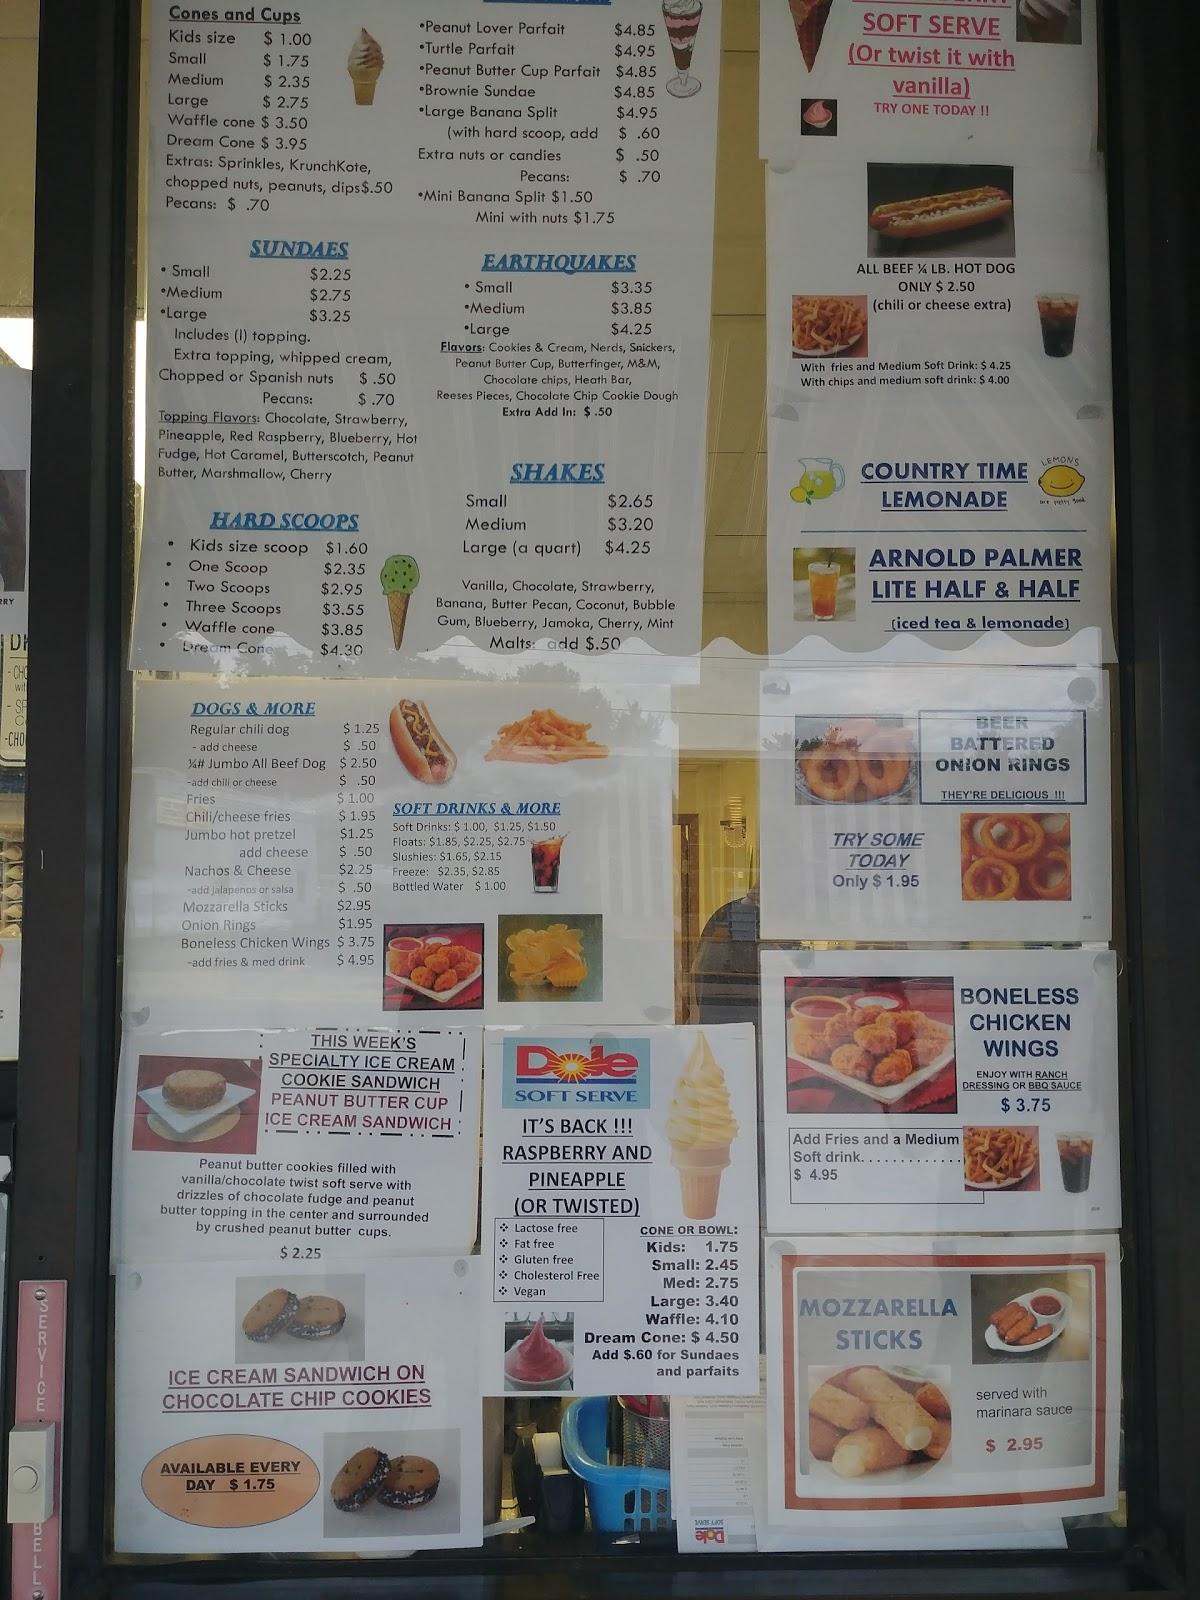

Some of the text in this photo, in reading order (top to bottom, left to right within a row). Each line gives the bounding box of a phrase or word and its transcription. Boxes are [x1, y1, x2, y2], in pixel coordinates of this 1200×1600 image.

[169, 5, 301, 25] Cones and Cups
[862, 12, 1000, 36] SOFT SERVE
[848, 42, 1015, 68] (Or twist it with
[893, 76, 971, 97] vanilla)
[873, 101, 990, 117] TRY ONE TODAY !!
[167, 113, 308, 130] Waffle cone $ 3.50
[166, 154, 371, 175] Extras: Sprinkles, KrunchKote,
[475, 211, 615, 225] Mini with nuts $1.75
[249, 239, 349, 257] SUNDAES
[481, 253, 637, 275] EARTHQUAKES
[856, 262, 880, 275] ALL
[883, 262, 914, 275] BEEF
[931, 262, 950, 275] LB.
[953, 262, 983, 275] HOT
[985, 262, 1016, 275] DOG
[172, 264, 352, 282] Small $2.25
[455, 358, 661, 371] Peanut Butter Cup, Butterfinger, M&M,
[158, 410, 409, 428] Topping Flavors: Chocolate, Strawberry,
[510, 462, 606, 481] SHAKES
[860, 462, 1028, 480] COUNTRY TIME
[881, 489, 1008, 508] LEMONADE
[209, 511, 360, 530] HARD SCOOPS
[463, 541, 651, 558] Large (a quart) $4.25
[868, 548, 1083, 568] ARNOLD PALMER
[186, 600, 365, 617] Three Scoops $3.55
[437, 615, 674, 631] Gum, Blueberry, Jamoka, Cherry, Mint
[891, 616, 1070, 630] (iced tea & lemonade)
[190, 702, 316, 716] DOGS & MORE
[190, 723, 380, 736] Regular chili dog $ 1.25
[935, 757, 1071, 772] ONION RINGS
[990, 789, 1049, 800] DELICIOUS
[1054, 789, 1065, 800] !!!
[393, 802, 561, 815] SOFT DRINKS & MORE
[831, 832, 925, 846] TRY SOME
[392, 851, 502, 863] Slushies: $1.65, $2.15
[847, 853, 911, 868] TODAY
[181, 936, 375, 951] Boneless Chicken Wings $ 3.75
[960, 987, 1080, 1005] BONELESS
[969, 1013, 1071, 1031] CHICKEN
[310, 1033, 349, 1049] THIS
[983, 1039, 1059, 1058] WINGS
[516, 1045, 639, 1083] Dole
[976, 1070, 1068, 1080] ENJOY WITH RANCH
[515, 1090, 638, 1102] SOFT SERVE
[560, 1118, 608, 1134] BACK
[613, 1118, 633, 1134] !!!
[792, 1133, 960, 1146] Add Fries and a Medium
[199, 1158, 397, 1175] Peanut butter cookies filled with
[528, 1171, 626, 1188] PINEAPPLE
[514, 1223, 578, 1233] Lactose free
[639, 1225, 739, 1235] CONE OR BOWL:
[651, 1259, 739, 1272] Small: 2.45
[513, 1286, 546, 1298] Vegan
[799, 1298, 958, 1318] MOZZARELLA
[836, 1329, 923, 1350] STICKS
[35, 1299, 49, 1413] SERVICE
[168, 1364, 425, 1387] ICE CREAM SANDWICH ON
[976, 1387, 1048, 1401] served with
[976, 1403, 1073, 1419] marinara sauce
[159, 1461, 301, 1475] AVAILABLE EVERY
[186, 1478, 275, 1492] DAY $ 1.75
[695, 1530, 725, 1544] Dole
